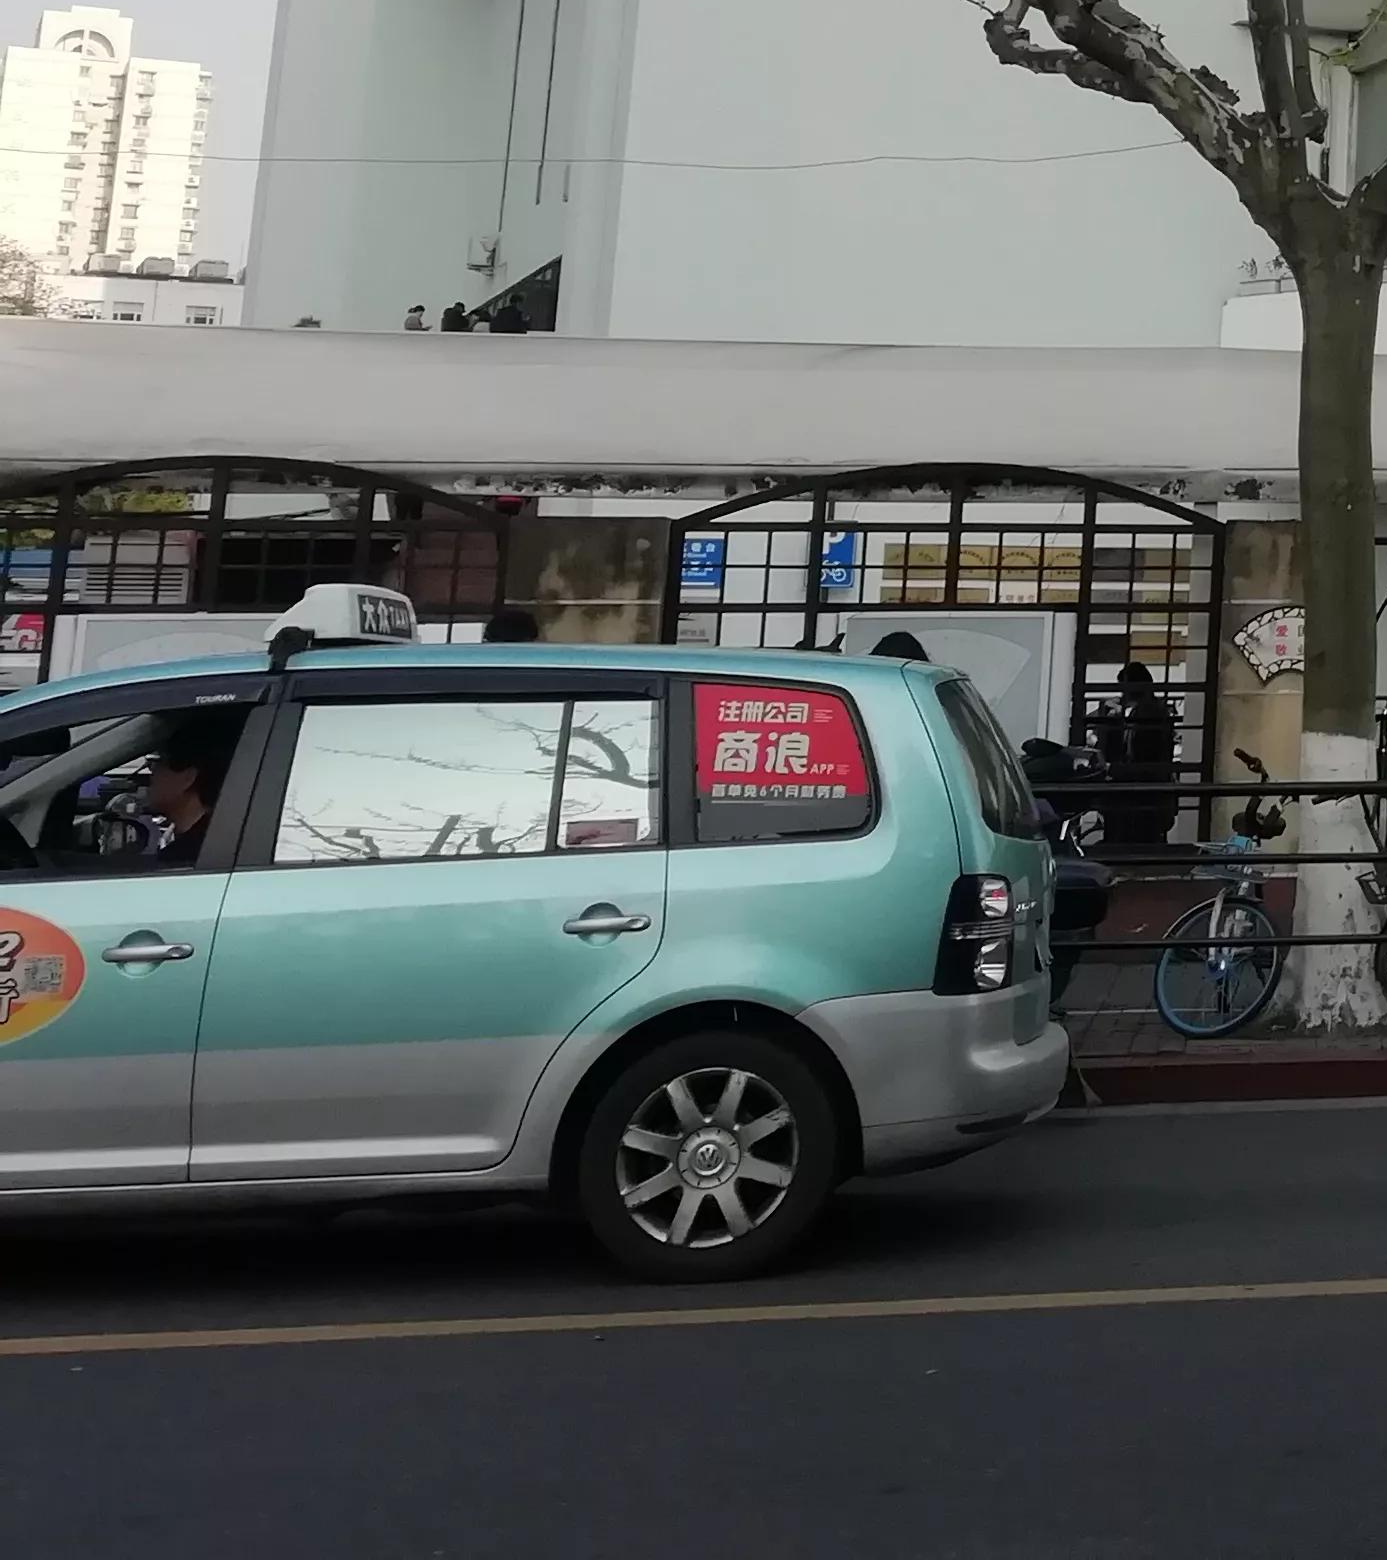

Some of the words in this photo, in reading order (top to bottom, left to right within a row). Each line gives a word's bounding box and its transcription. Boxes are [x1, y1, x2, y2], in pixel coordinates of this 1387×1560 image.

[362, 596, 391, 635] 大众
[718, 700, 810, 724] 注册公司
[713, 730, 810, 775] 商浪
[810, 763, 835, 775] APP
